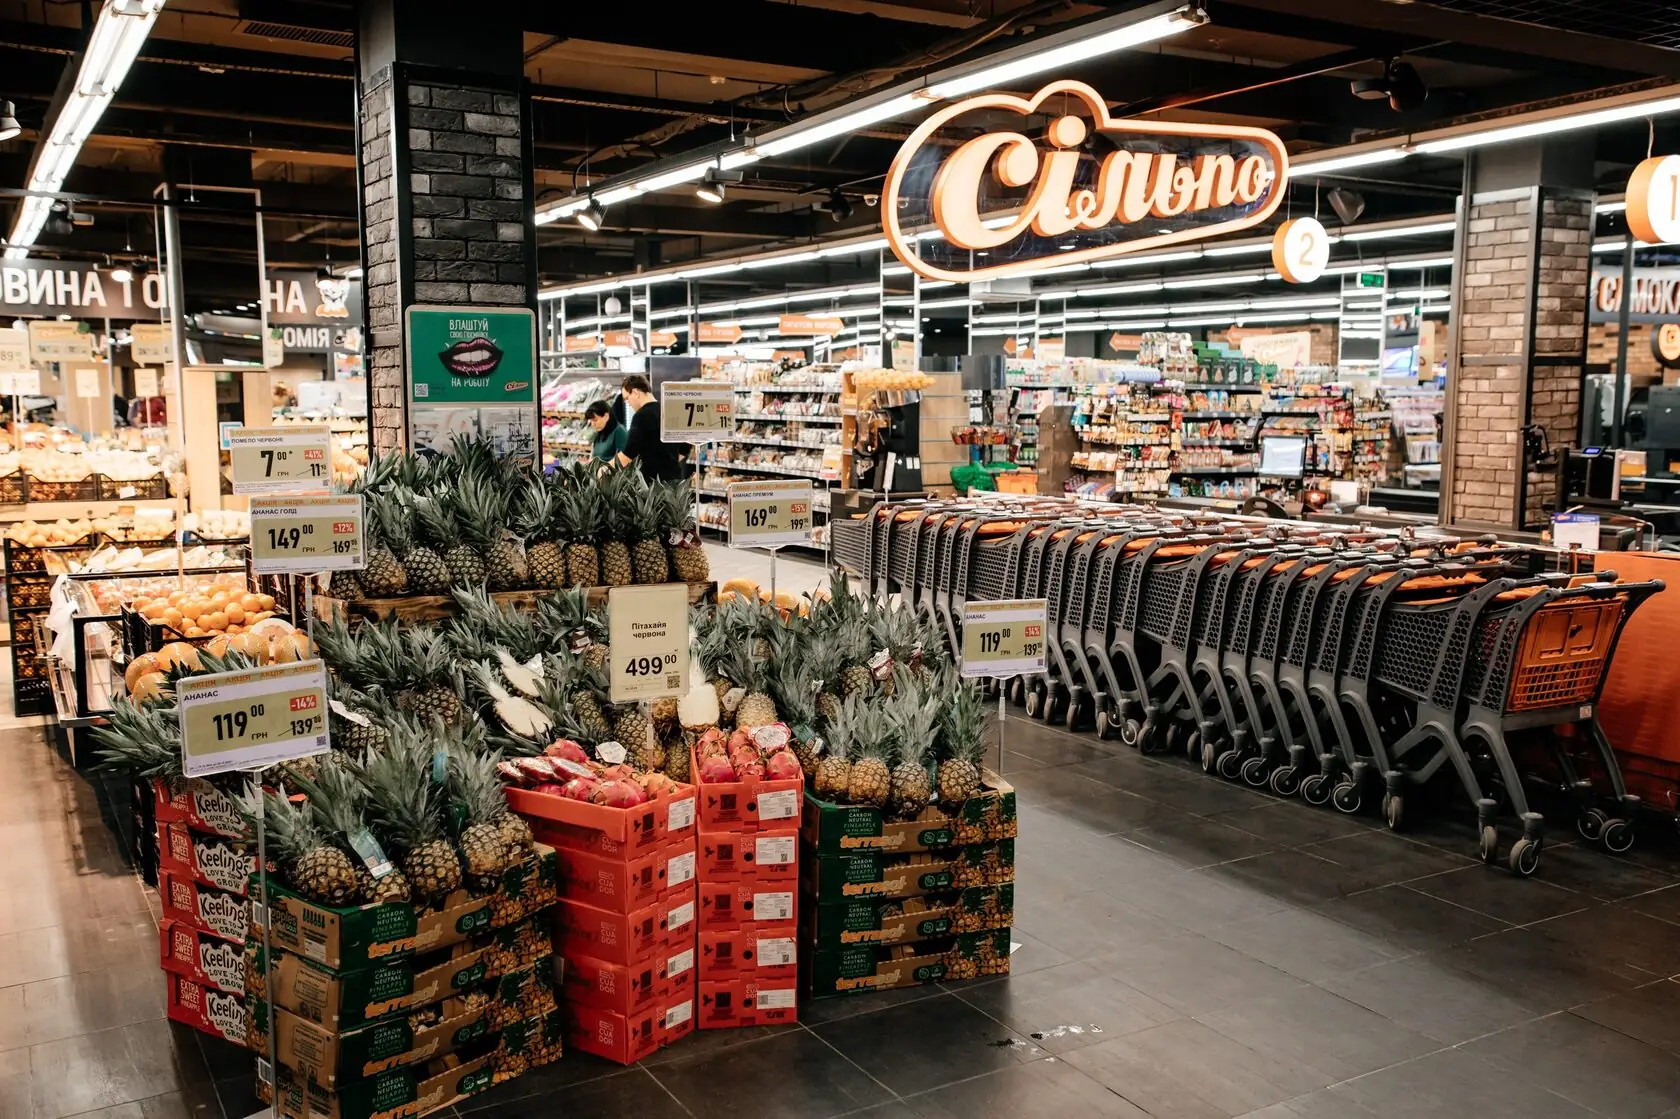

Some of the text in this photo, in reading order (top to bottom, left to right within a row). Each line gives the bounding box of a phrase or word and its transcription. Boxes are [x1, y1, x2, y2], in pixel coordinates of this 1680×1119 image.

[934, 115, 1268, 250] Сільпо
[1300, 233, 1315, 265] 2
[0, 267, 107, 308] ВИНА
[449, 318, 489, 331] ВЛАШТУЙ
[283, 326, 331, 348] ОМІЯ
[451, 377, 490, 388] НА РОБОТУ
[685, 403, 695, 427] 7
[720, 416, 727, 428] 11
[231, 437, 257, 445] ПОМЕЛО
[304, 450, 322, 460] -41%
[260, 450, 287, 477] 7 00
[310, 463, 320, 477] 11
[744, 505, 778, 527] 169 00
[333, 523, 354, 534] -12%
[790, 518, 804, 530] 199
[268, 524, 313, 550] 149 00
[332, 540, 351, 554] 169
[631, 621, 667, 630] Пітахайя
[632, 630, 666, 640] червона
[980, 628, 1011, 653] 119 00
[1023, 643, 1037, 656] 139
[625, 654, 677, 676] 499 00
[191, 679, 217, 689] АКЦІЯ
[184, 690, 219, 701] АНАНАС
[290, 696, 315, 710] -14%
[212, 703, 265, 741] 119 00
[290, 717, 313, 736] 139
[251, 732, 268, 741] ГРН
[204, 814, 222, 823] LOVE
[196, 848, 249, 879] Keelings
[206, 869, 225, 877] LOVE
[172, 881, 191, 895] EXTRA
[216, 878, 241, 889] GROW
[172, 891, 192, 906] SWEET
[207, 917, 227, 925] LOVE
[376, 909, 405, 920] CARBON
[376, 916, 405, 926] NEUTRAL
[175, 931, 194, 944] EXTRA
[220, 926, 242, 939] GROW
[601, 929, 616, 938] CUA
[174, 942, 194, 957] SWEET
[201, 947, 245, 981] Keeling
[208, 968, 228, 978] LOVE
[374, 969, 402, 980] CARBON
[180, 979, 200, 995] EXTRA
[220, 979, 243, 990] GROW
[368, 979, 407, 994] PINEAPPLE
[374, 975, 401, 986] NEUTRAL
[180, 989, 200, 1005] SWEET
[215, 1019, 234, 1028] LOVE
[374, 1028, 402, 1039] CARBON
[599, 1028, 614, 1038] CUA
[599, 1036, 614, 1046] DOR
[377, 1076, 405, 1089] CARBON
[377, 1083, 405, 1095] NEUTRAL
